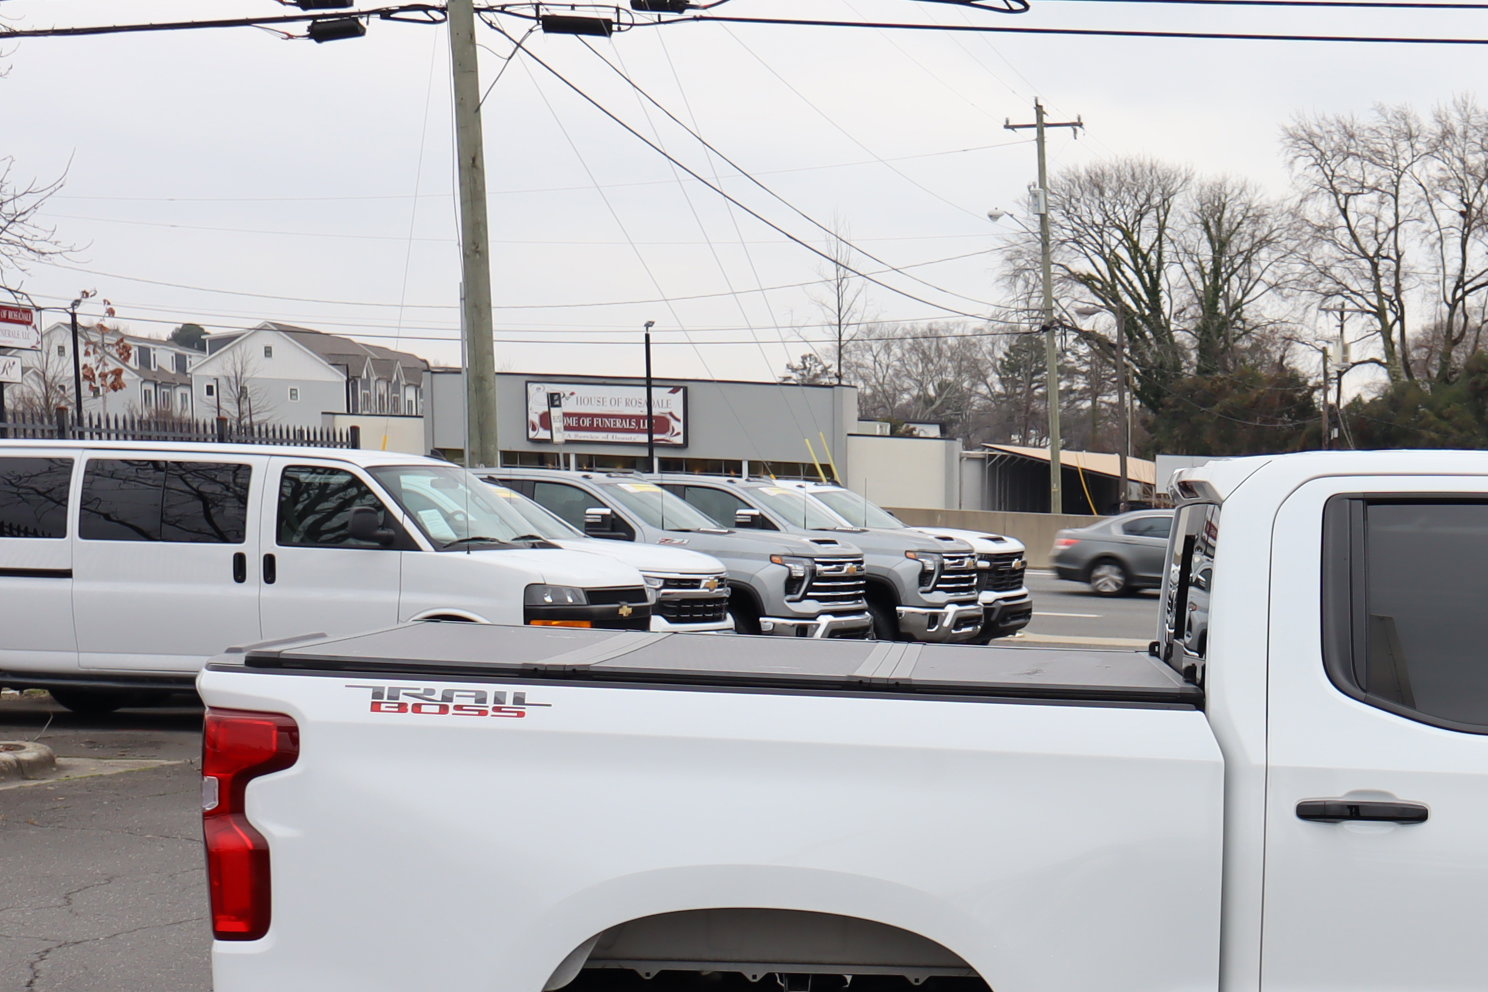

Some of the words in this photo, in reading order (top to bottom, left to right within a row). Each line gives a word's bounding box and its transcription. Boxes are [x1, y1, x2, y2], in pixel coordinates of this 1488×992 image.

[575, 396, 607, 406] HOUSE
[609, 397, 622, 407] OF
[580, 417, 591, 428] OF
[593, 418, 638, 430] FUNERALS,
[345, 685, 552, 707] TRAIL
[370, 701, 526, 718] BOSS
